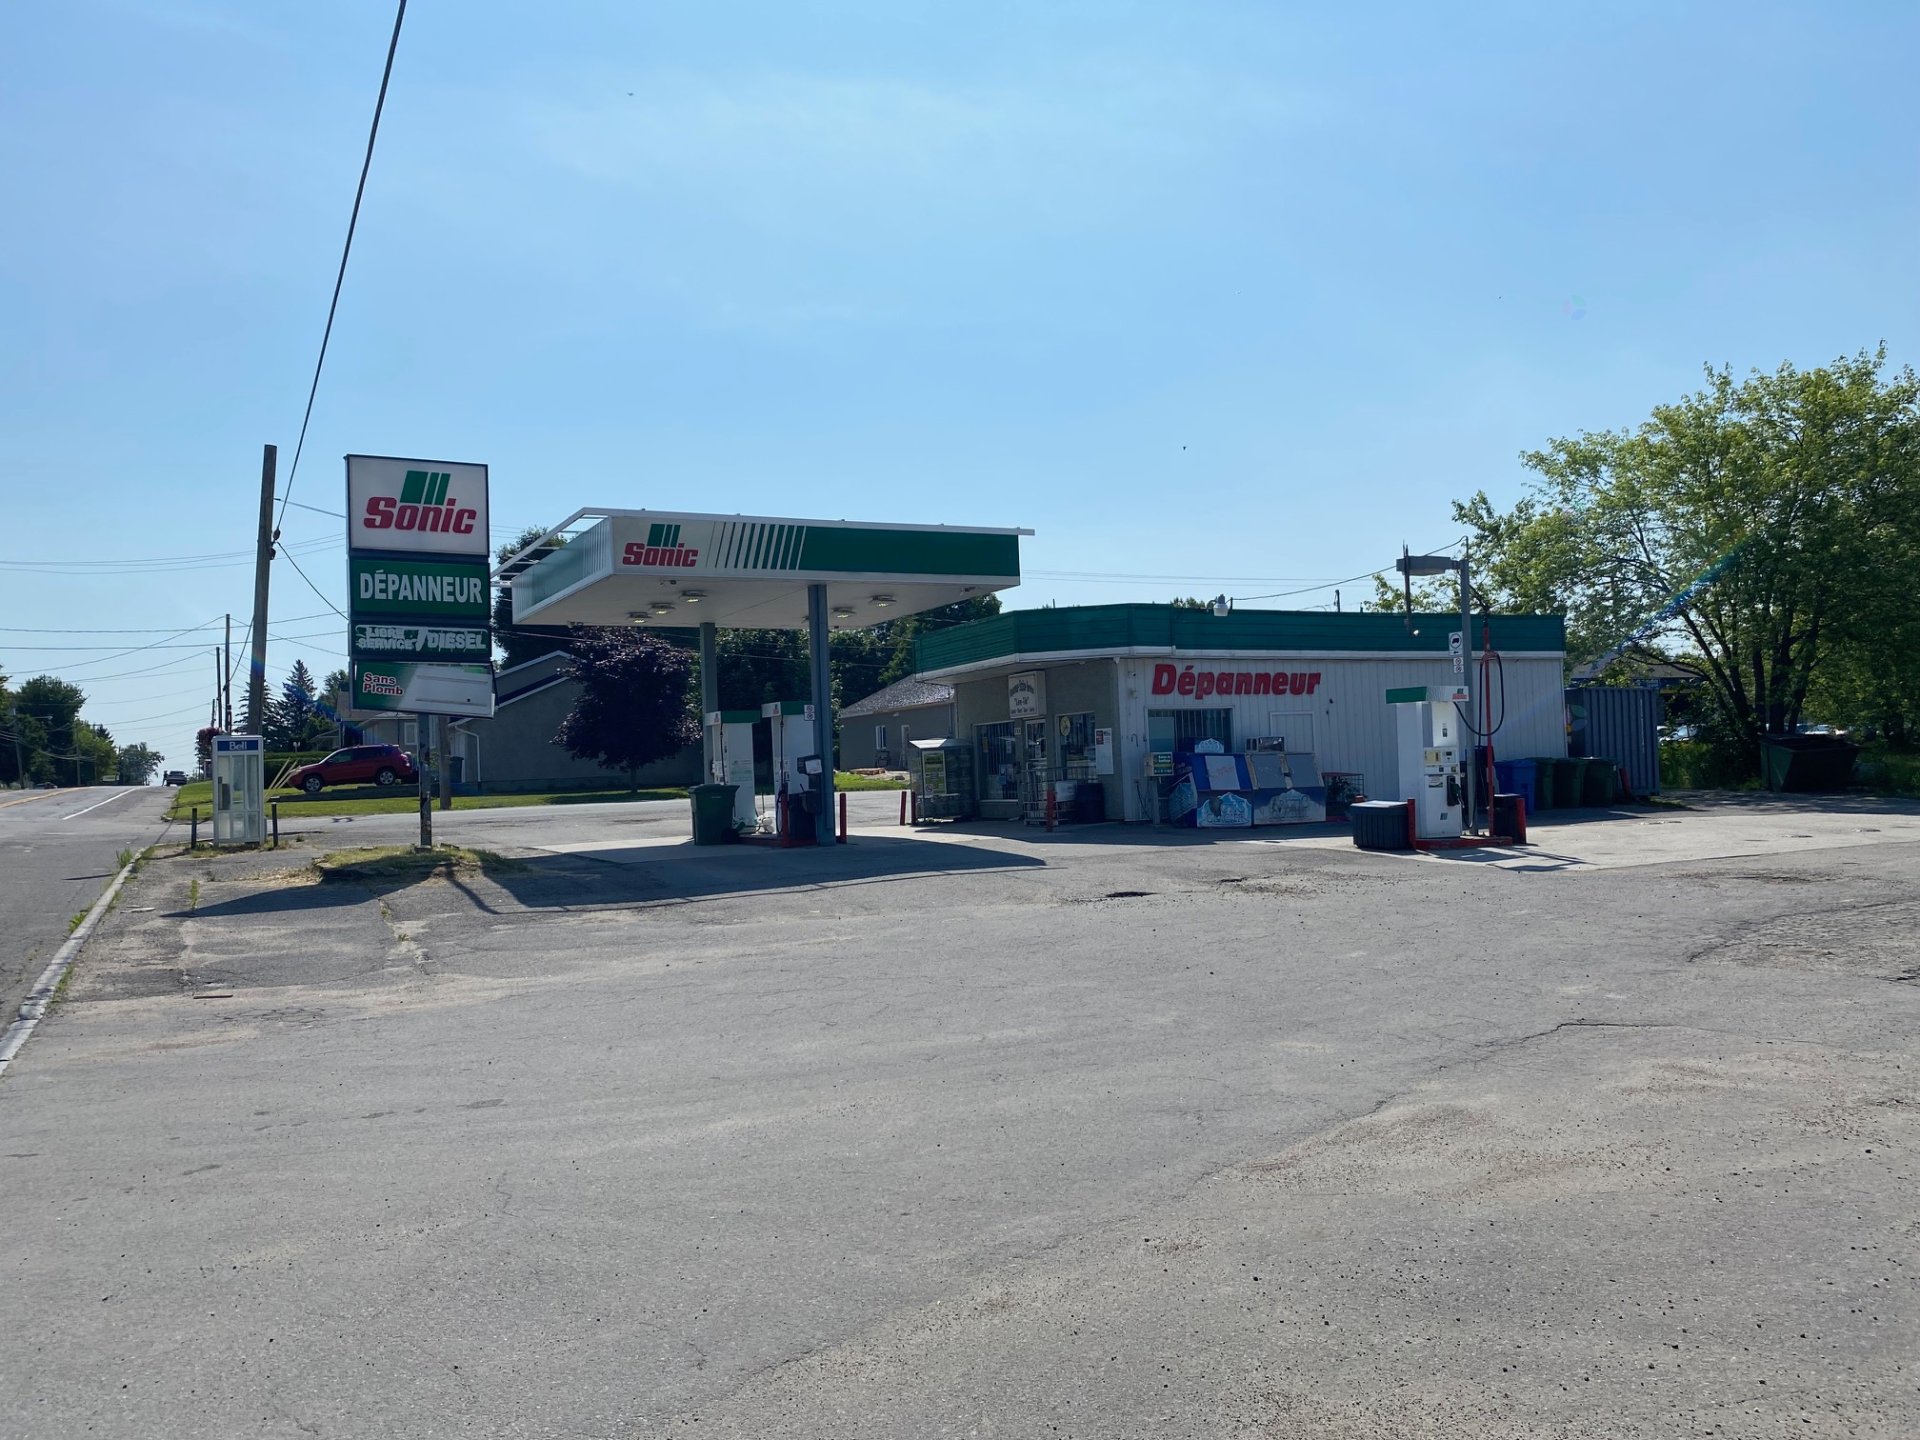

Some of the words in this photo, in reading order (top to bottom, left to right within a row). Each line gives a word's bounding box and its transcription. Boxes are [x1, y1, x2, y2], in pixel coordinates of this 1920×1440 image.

[363, 496, 477, 534] Sonic
[622, 542, 699, 567] Sonic
[359, 569, 483, 604] DÉPANNEUR
[427, 631, 487, 650] DIESEL
[363, 682, 404, 695] Plomb
[364, 672, 397, 685] Sans
[1152, 664, 1321, 700] Dépanneur
[229, 741, 247, 750] Bell
